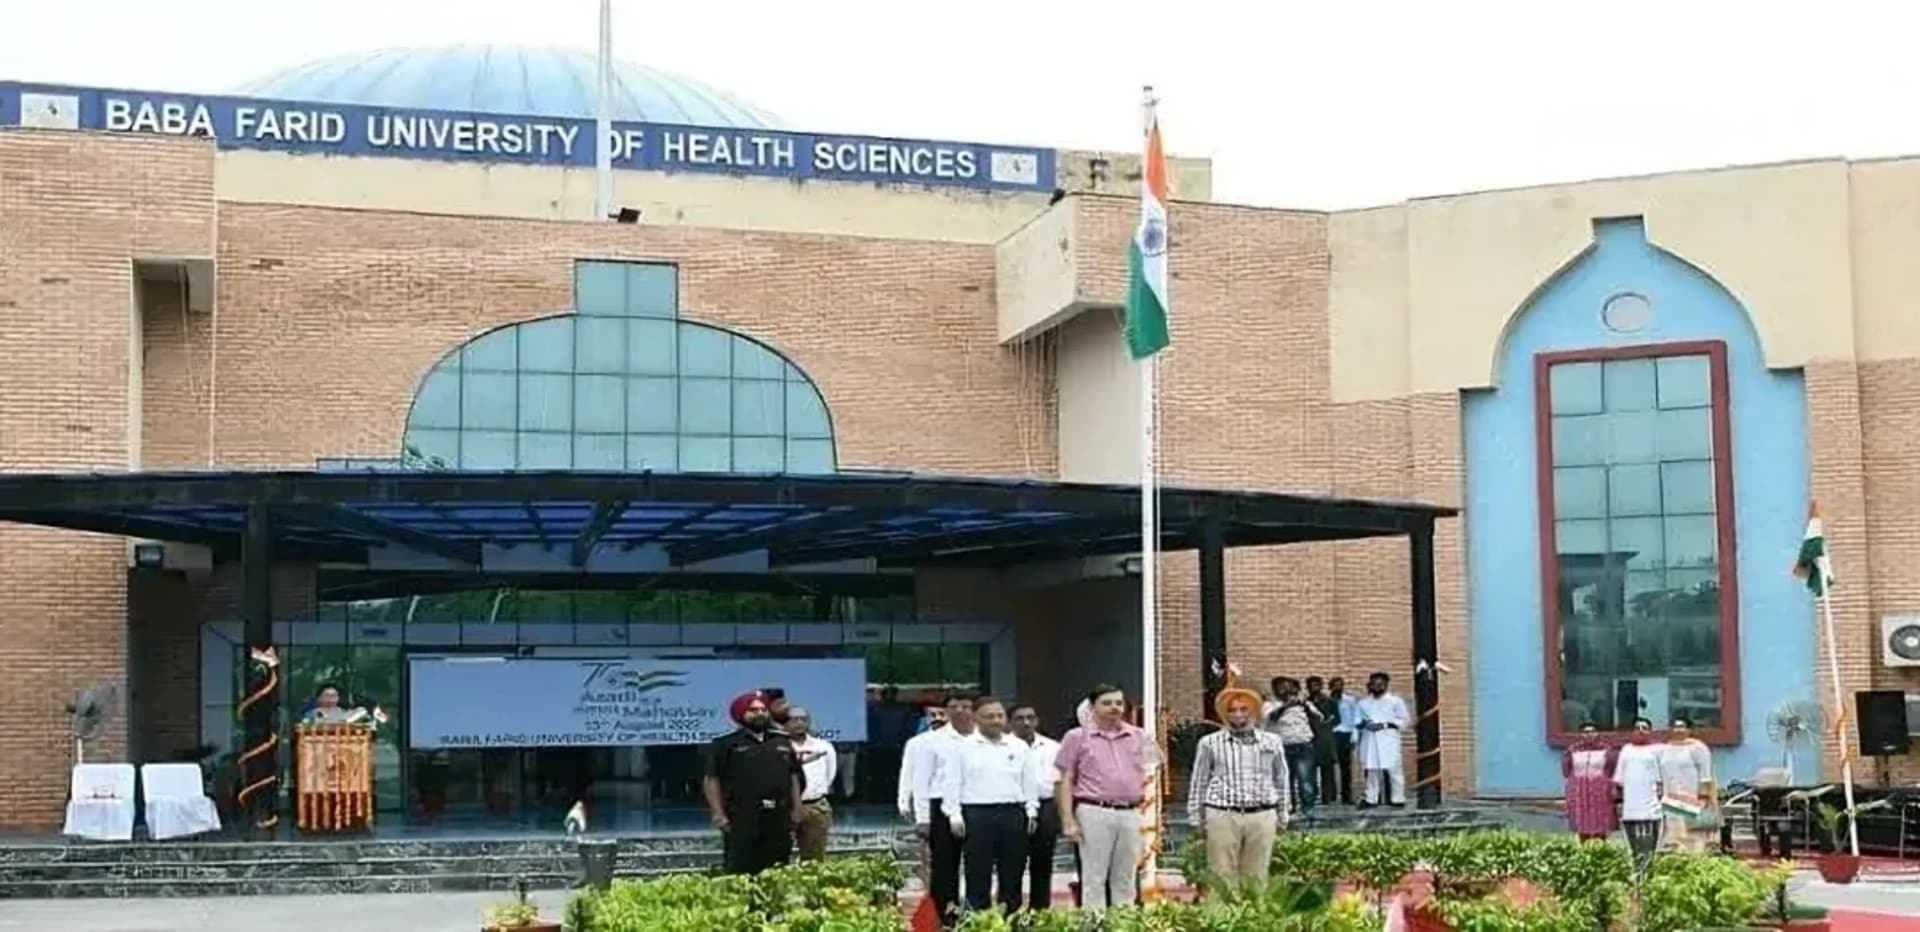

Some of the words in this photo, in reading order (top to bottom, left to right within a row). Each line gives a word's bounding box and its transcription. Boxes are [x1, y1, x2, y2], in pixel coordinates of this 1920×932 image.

[105, 98, 216, 138] BABA
[235, 107, 346, 143] FARID
[366, 115, 580, 154] UNIVERSITY
[663, 132, 795, 168] HEALTH
[813, 141, 977, 177] SCIENCES
